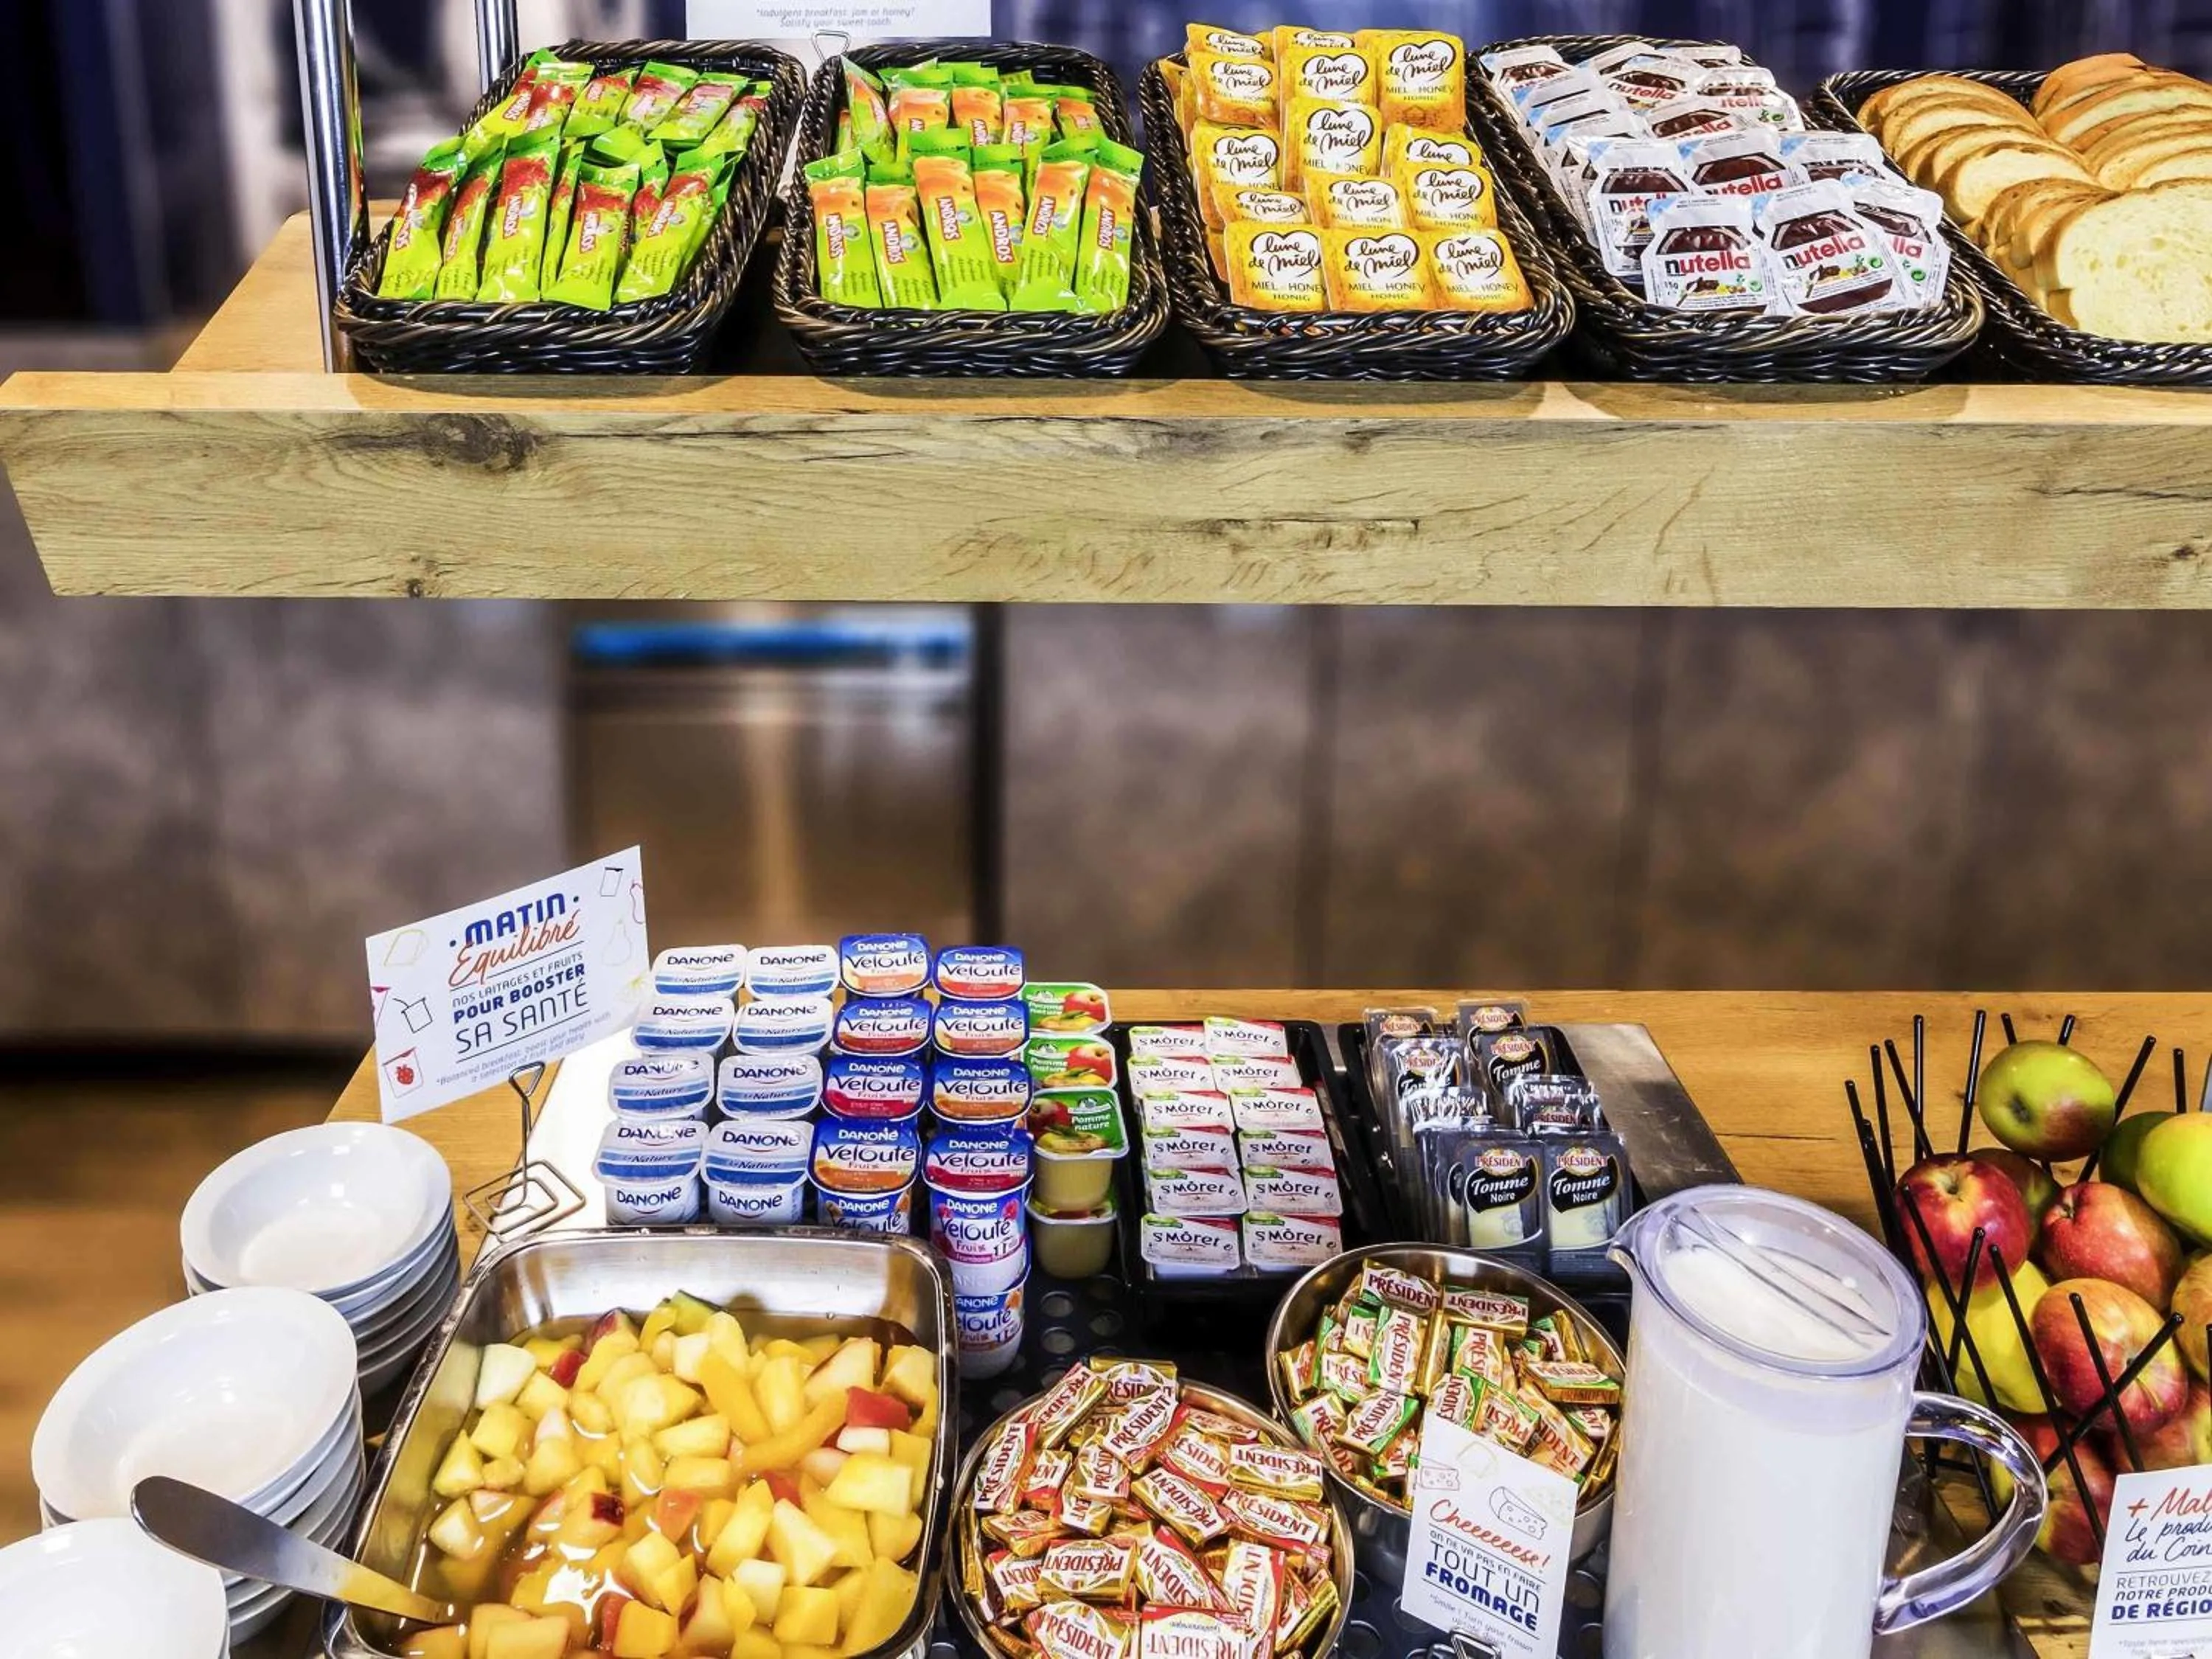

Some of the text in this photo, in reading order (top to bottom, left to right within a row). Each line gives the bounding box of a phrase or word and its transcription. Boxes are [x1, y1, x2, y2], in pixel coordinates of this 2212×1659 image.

[1402, 47, 1440, 63] lune
[1402, 60, 1448, 81] miel
[1608, 82, 1677, 102] nutella
[1318, 115, 1354, 130] lune
[1320, 130, 1366, 150] miel
[1425, 173, 1464, 188] lune
[1433, 184, 1476, 207] miel
[936, 198, 960, 240] ANDROS
[1034, 196, 1054, 236] ANDROS
[991, 212, 1014, 262] ANDROS
[1099, 209, 1114, 250] ANDROS
[883, 221, 905, 262] ANDROS
[1262, 237, 1304, 253] lune
[1360, 240, 1400, 255] lune
[1447, 243, 1485, 258] lune
[1782, 232, 1866, 270] nutella
[1270, 254, 1319, 277] miel
[1364, 255, 1416, 279] miel
[1455, 258, 1500, 279] miel
[1665, 251, 1751, 274] nutella
[465, 893, 565, 945] MATIN
[846, 952, 925, 970] Velouté
[941, 960, 1020, 977] Velouté
[479, 973, 528, 999] LAITAGES
[532, 967, 543, 978] ET
[548, 953, 583, 973] FRUITS
[453, 964, 585, 1023] POUR BOOSTER
[456, 979, 588, 1054] SA SANTÉ
[845, 1016, 927, 1032] Velouté
[1493, 1060, 1540, 1082] Tomme
[833, 1074, 919, 1093] Velouté
[939, 1078, 1027, 1096] Velouté
[1071, 1114, 1110, 1124] Pomme
[1074, 1121, 1110, 1131] nature
[821, 1141, 914, 1162] Velouté
[934, 1150, 1026, 1167] Velouté
[1557, 1156, 1608, 1167] PRÉSIDENT
[1472, 1175, 1528, 1194] Tomme
[1554, 1175, 1610, 1194] Tomme
[1491, 1193, 1515, 1203] Noire
[1573, 1192, 1598, 1202] Noire
[941, 1217, 1010, 1240] Velouté
[1368, 1276, 1440, 1310] PRÉSIDENT
[1387, 1316, 1411, 1386] PRÉSIDENT
[1352, 1391, 1399, 1442] PRÉSIDENT
[1476, 1553, 1495, 1568] PAS
[2126, 1541, 2157, 1562] du
[1430, 1541, 1539, 1613] TOUT UN
[2116, 1571, 2211, 1589] RETROUVEZ
[1426, 1562, 1537, 1631] FROMAGE
[2115, 1588, 2164, 1601] NOTRE
[2112, 1604, 2139, 1620] DE
